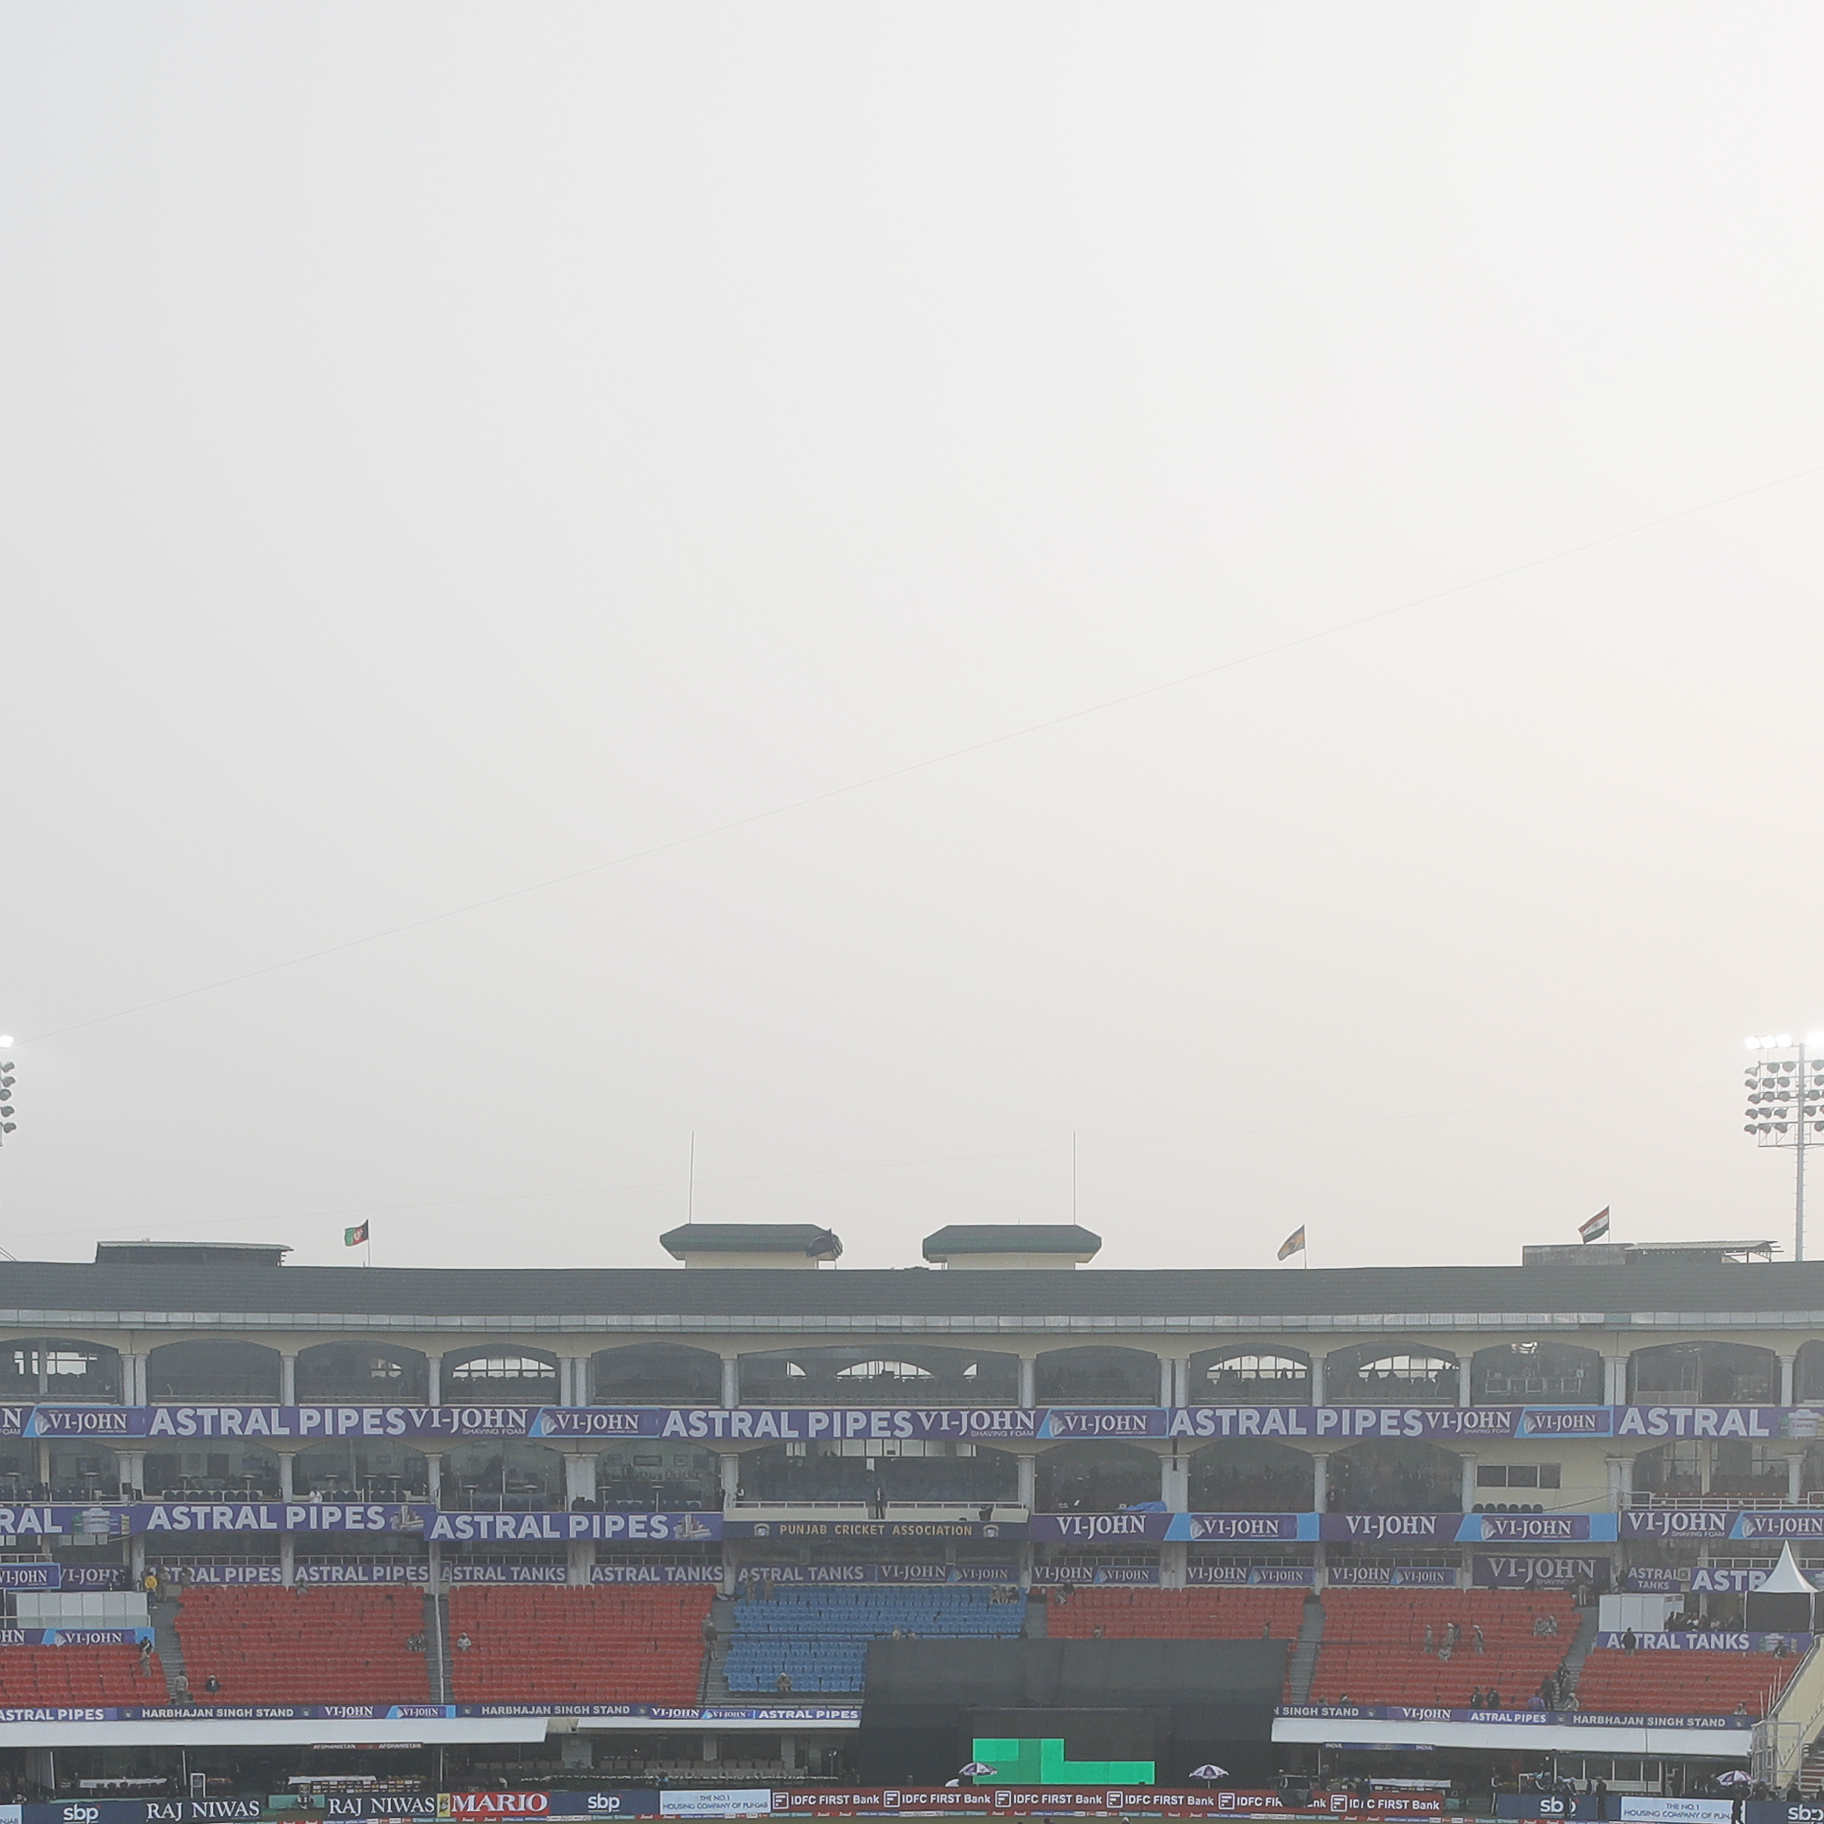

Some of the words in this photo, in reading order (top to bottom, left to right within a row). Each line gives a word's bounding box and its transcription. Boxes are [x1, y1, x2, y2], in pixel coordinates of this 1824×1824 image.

[49, 1412, 128, 1432] VI-JOHN
[150, 1408, 290, 1436] ASTRAL
[299, 1408, 406, 1436] PIPES
[409, 1408, 529, 1433] VI-JOHN
[556, 1413, 640, 1432] VI-JOHN
[662, 1410, 799, 1438] ASTRAL
[809, 1410, 914, 1438] PIPES
[919, 1410, 1037, 1436] VI-JOHN
[1065, 1415, 1148, 1433] VI-JOHN
[1169, 1409, 1307, 1436] ASTRAL
[1317, 1409, 1423, 1437] PIPES
[1427, 1411, 1512, 1432] VI-JOHN
[1535, 1413, 1596, 1430] VI-JOHN
[1619, 1408, 1769, 1437] ASTRAL
[147, 1506, 277, 1531] ASTRAL
[286, 1506, 385, 1530] PIPES
[431, 1515, 561, 1540] ASTRAL
[569, 1515, 669, 1539] PIPES
[1057, 1516, 1146, 1540] VI-JOHN
[1204, 1519, 1280, 1537] VI-JOHN
[1346, 1516, 1437, 1540] VI-JOHN
[1628, 1512, 1727, 1537] VI-JOHN
[1756, 1517, 1824, 1535] VI-JOHN
[780, 1525, 828, 1536] PUNJAB
[835, 1525, 885, 1536] CRICKET
[892, 1525, 974, 1536] ASSOCIATION
[1496, 1520, 1572, 1537] VI-JOHN
[295, 1567, 368, 1582] ASTRAL
[373, 1567, 429, 1582] PIPES
[591, 1566, 660, 1581] ASTRAL
[664, 1566, 723, 1581] TANKS
[881, 1566, 947, 1580] VI-JOHN
[1187, 1567, 1247, 1582] VI-JOHN
[1488, 1558, 1597, 1582] VI-JOHN
[66, 1632, 122, 1645] VI-JOHN
[1686, 1633, 1750, 1649] TANKS
[57, 1709, 104, 1721] PIPES
[142, 1709, 213, 1719] HARBHAJAN
[216, 1709, 253, 1718] SINGH
[256, 1709, 294, 1718] STAND
[1573, 1715, 1644, 1726] HARBHAJAN
[1647, 1716, 1683, 1726] SINGH
[1686, 1717, 1725, 1727] STAND
[451, 1793, 548, 1813] MARIO
[588, 1793, 620, 1812] sbp
[791, 1794, 815, 1806] IDFC
[818, 1794, 850, 1806] FIRST
[852, 1794, 880, 1806] Bank
[147, 1803, 183, 1821] RAJ
[192, 1801, 260, 1818] NIWAS
